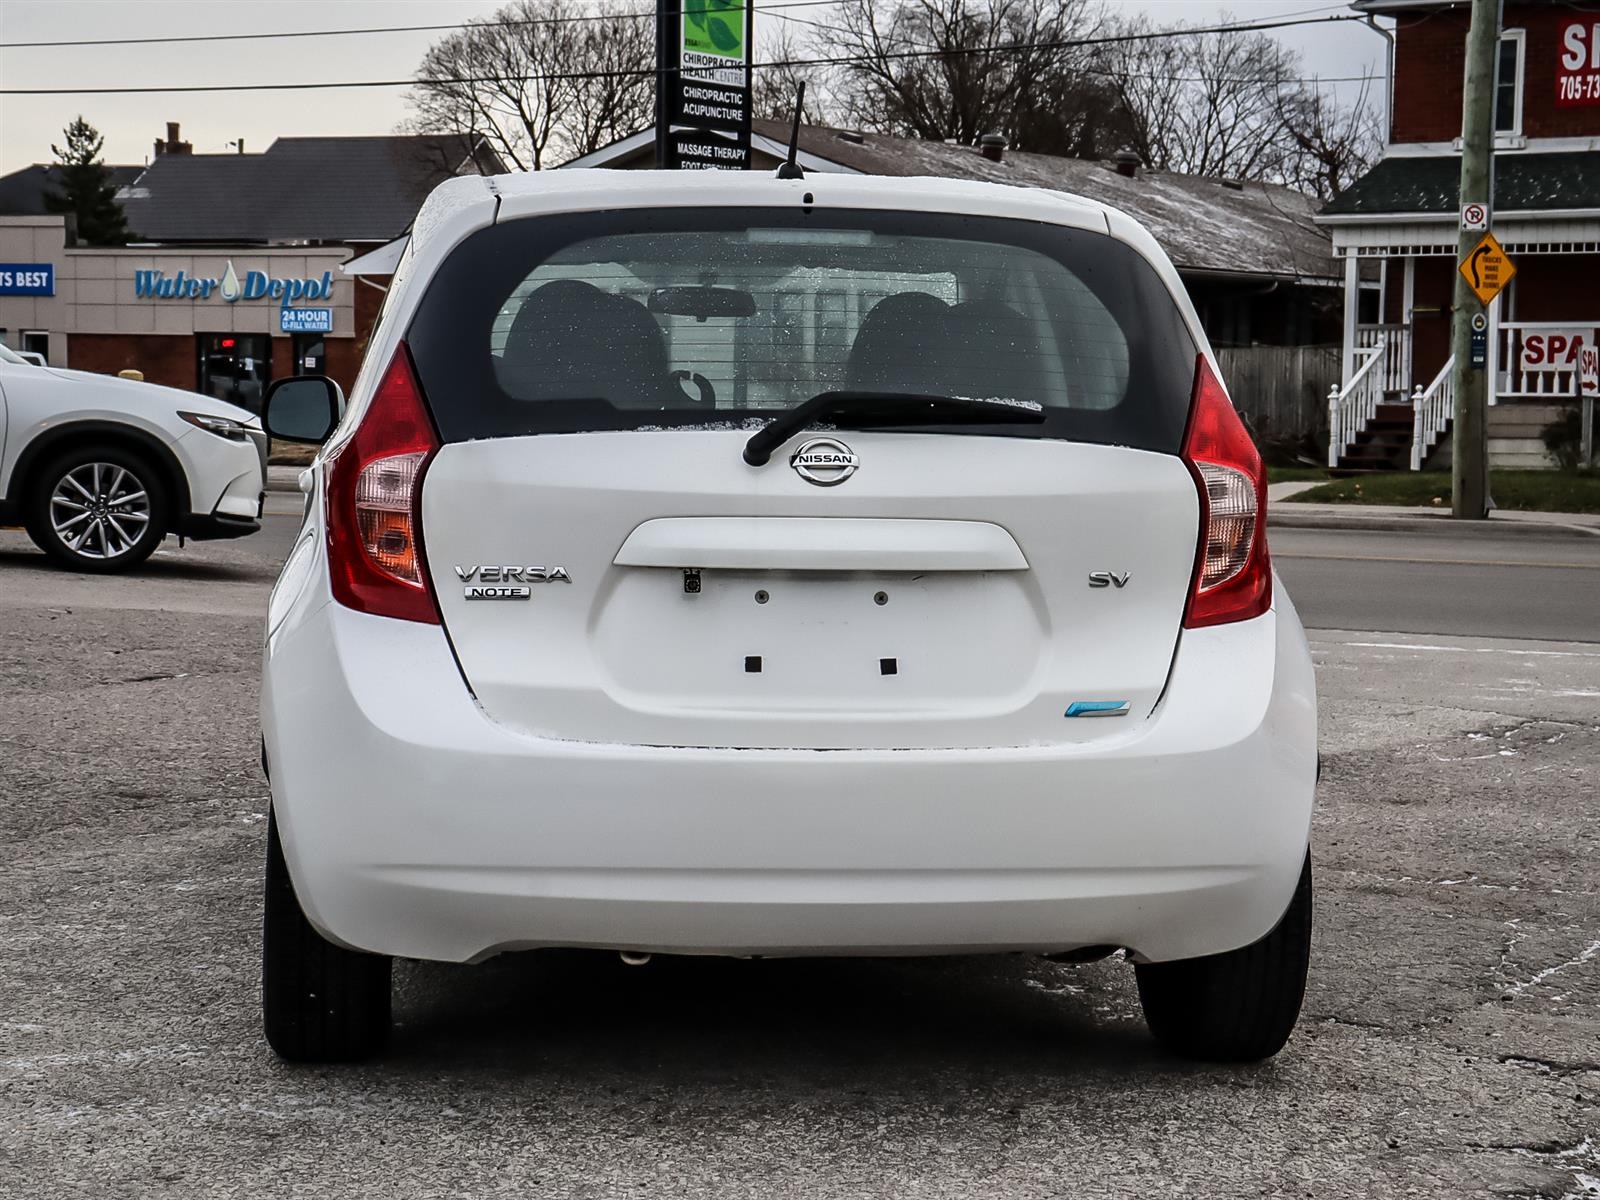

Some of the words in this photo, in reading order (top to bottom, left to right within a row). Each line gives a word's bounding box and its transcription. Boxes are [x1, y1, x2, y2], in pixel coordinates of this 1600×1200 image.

[683, 52, 743, 72] CHIROPRACTIC
[683, 86, 743, 105] CHIROPRACTIC
[683, 103, 743, 121] ACUPUNCTURE
[677, 143, 712, 157] MASSAGE
[714, 147, 746, 160] THERAPY
[16, 272, 48, 287] BEST
[134, 270, 218, 299] Water
[243, 270, 334, 308] Depot
[282, 310, 296, 321] 24
[297, 310, 328, 322] HOUR
[304, 321, 329, 330] WATER
[1524, 335, 1584, 364] SPA
[1582, 350, 1599, 376] SPA
[799, 454, 852, 464] NISSAN
[455, 565, 572, 584] VERSA
[1089, 570, 1132, 588] SV
[471, 588, 523, 597] NOTE
